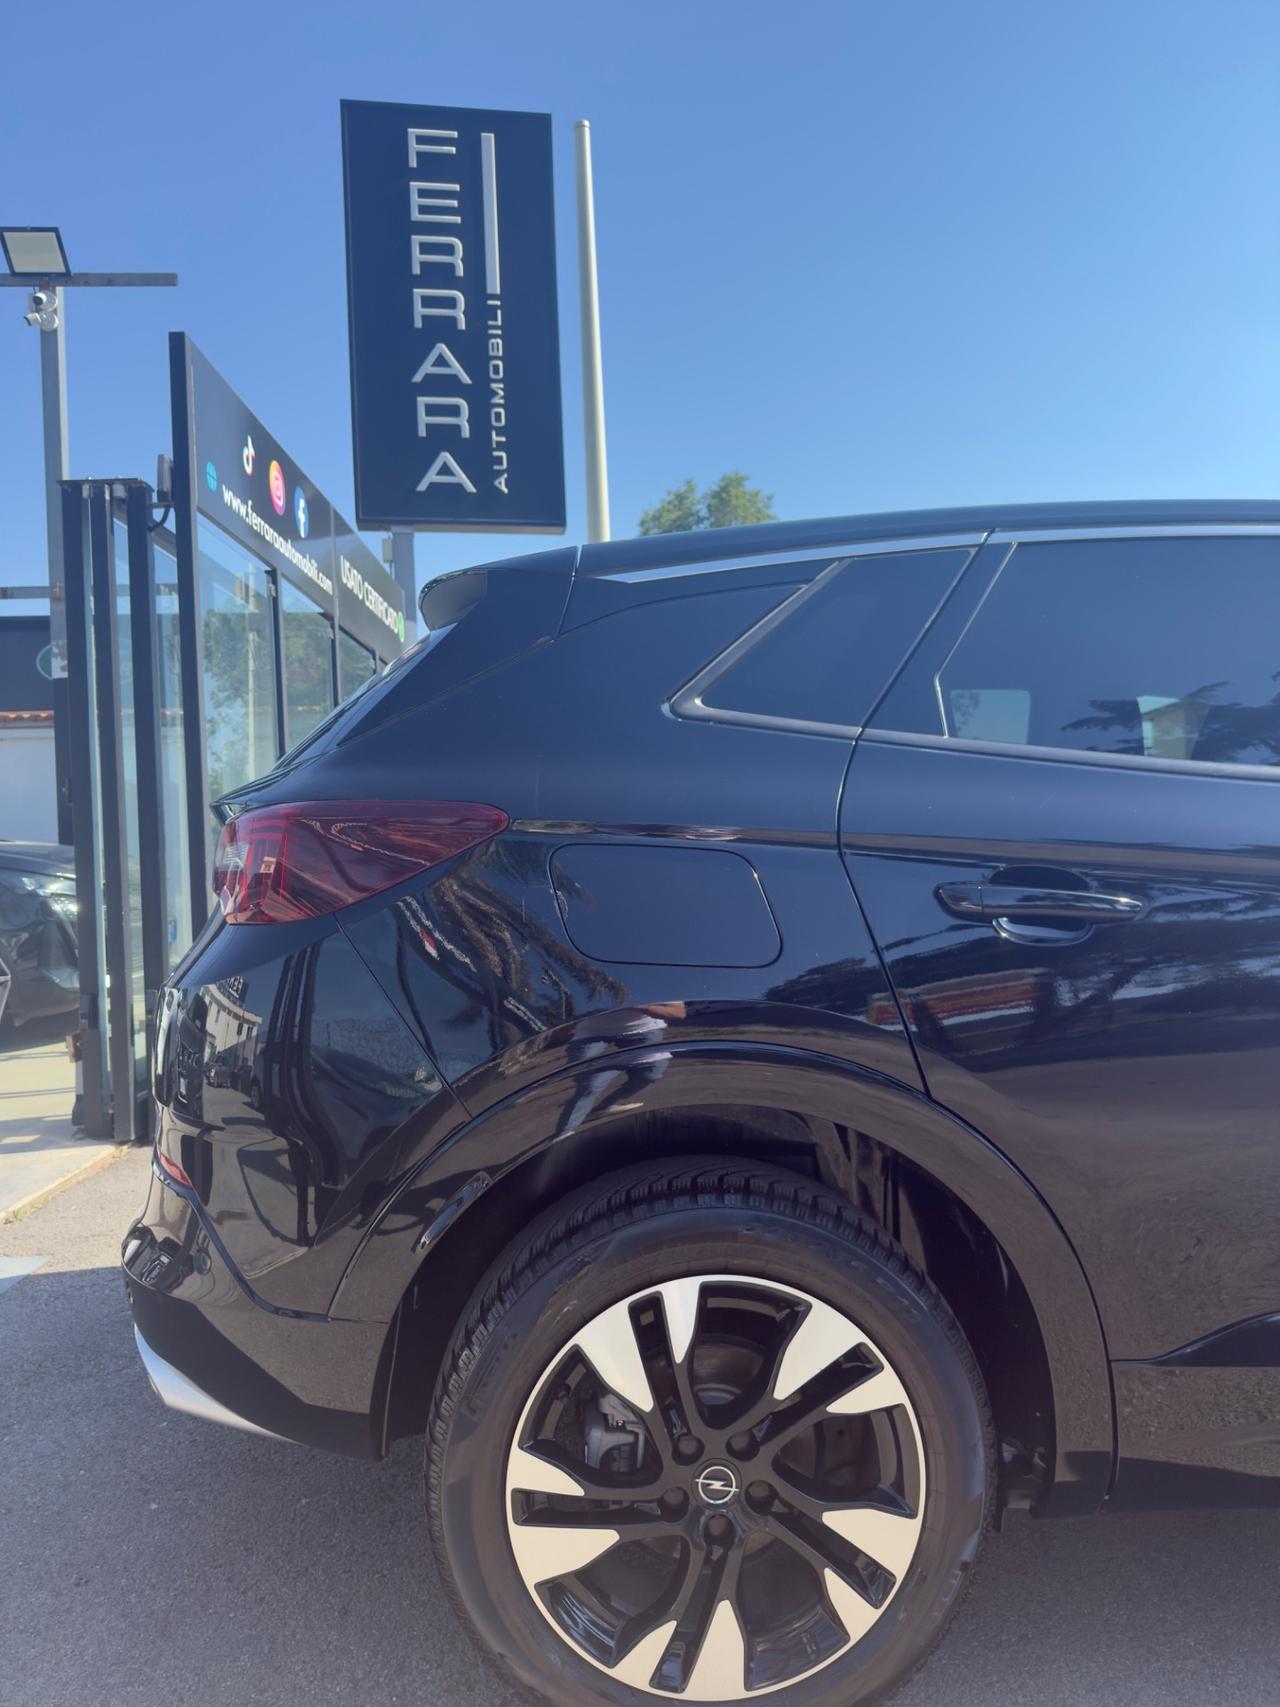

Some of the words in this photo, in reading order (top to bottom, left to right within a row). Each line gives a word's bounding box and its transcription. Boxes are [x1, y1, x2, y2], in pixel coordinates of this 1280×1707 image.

[407, 128, 477, 493] FERRARA
[486, 300, 508, 494] AUTOMOBILI
[222, 484, 333, 595] www.ferraraautomobili.com
[341, 555, 363, 600] USATO
